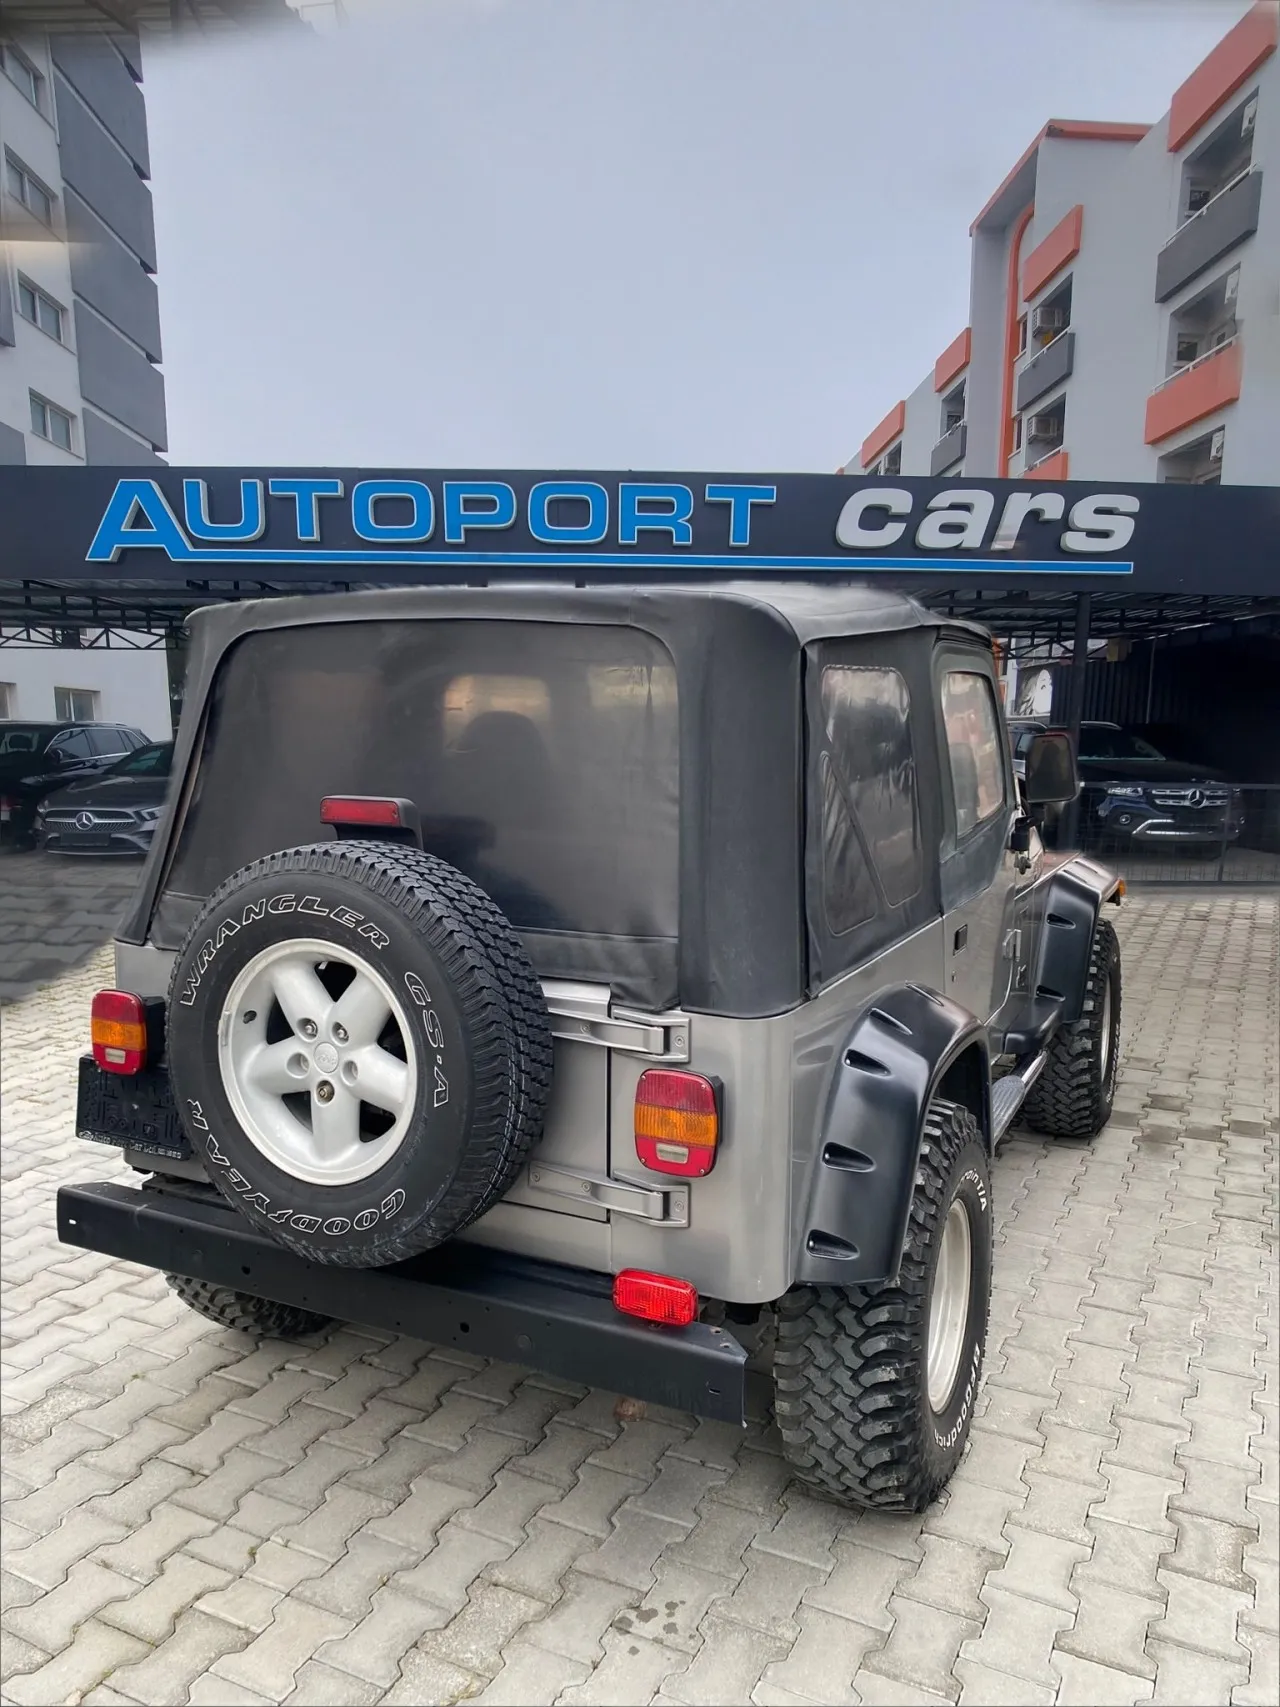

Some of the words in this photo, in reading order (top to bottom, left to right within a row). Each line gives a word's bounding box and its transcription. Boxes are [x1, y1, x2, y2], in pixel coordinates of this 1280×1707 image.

[85, 478, 778, 562] AUTOPORT
[834, 487, 1141, 554] cars
[180, 894, 390, 1006] WRANGLER
[187, 1098, 407, 1236] GOODYEAR
